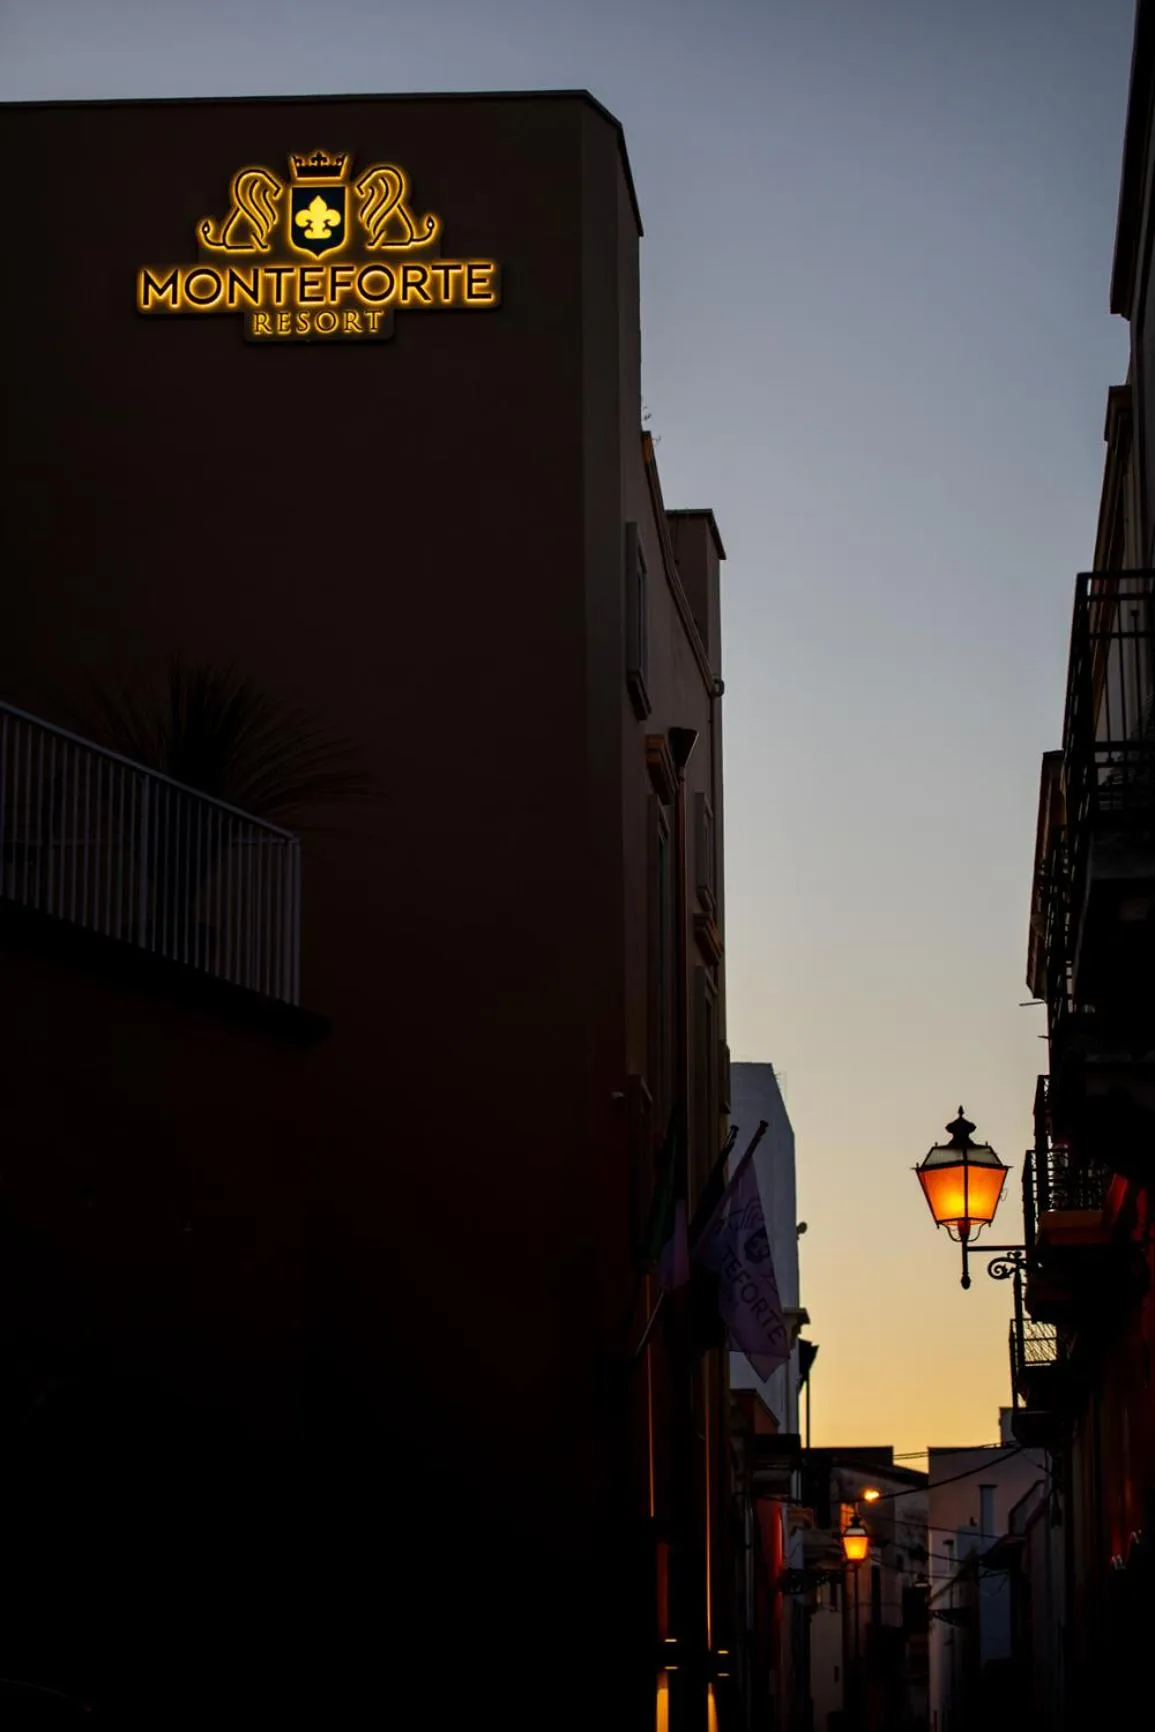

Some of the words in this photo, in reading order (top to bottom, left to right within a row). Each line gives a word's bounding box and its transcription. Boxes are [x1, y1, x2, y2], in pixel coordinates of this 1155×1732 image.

[142, 263, 495, 306] MONTEFORTE
[253, 311, 385, 335] RESORT
[721, 1245, 787, 1345] TEFORTE
